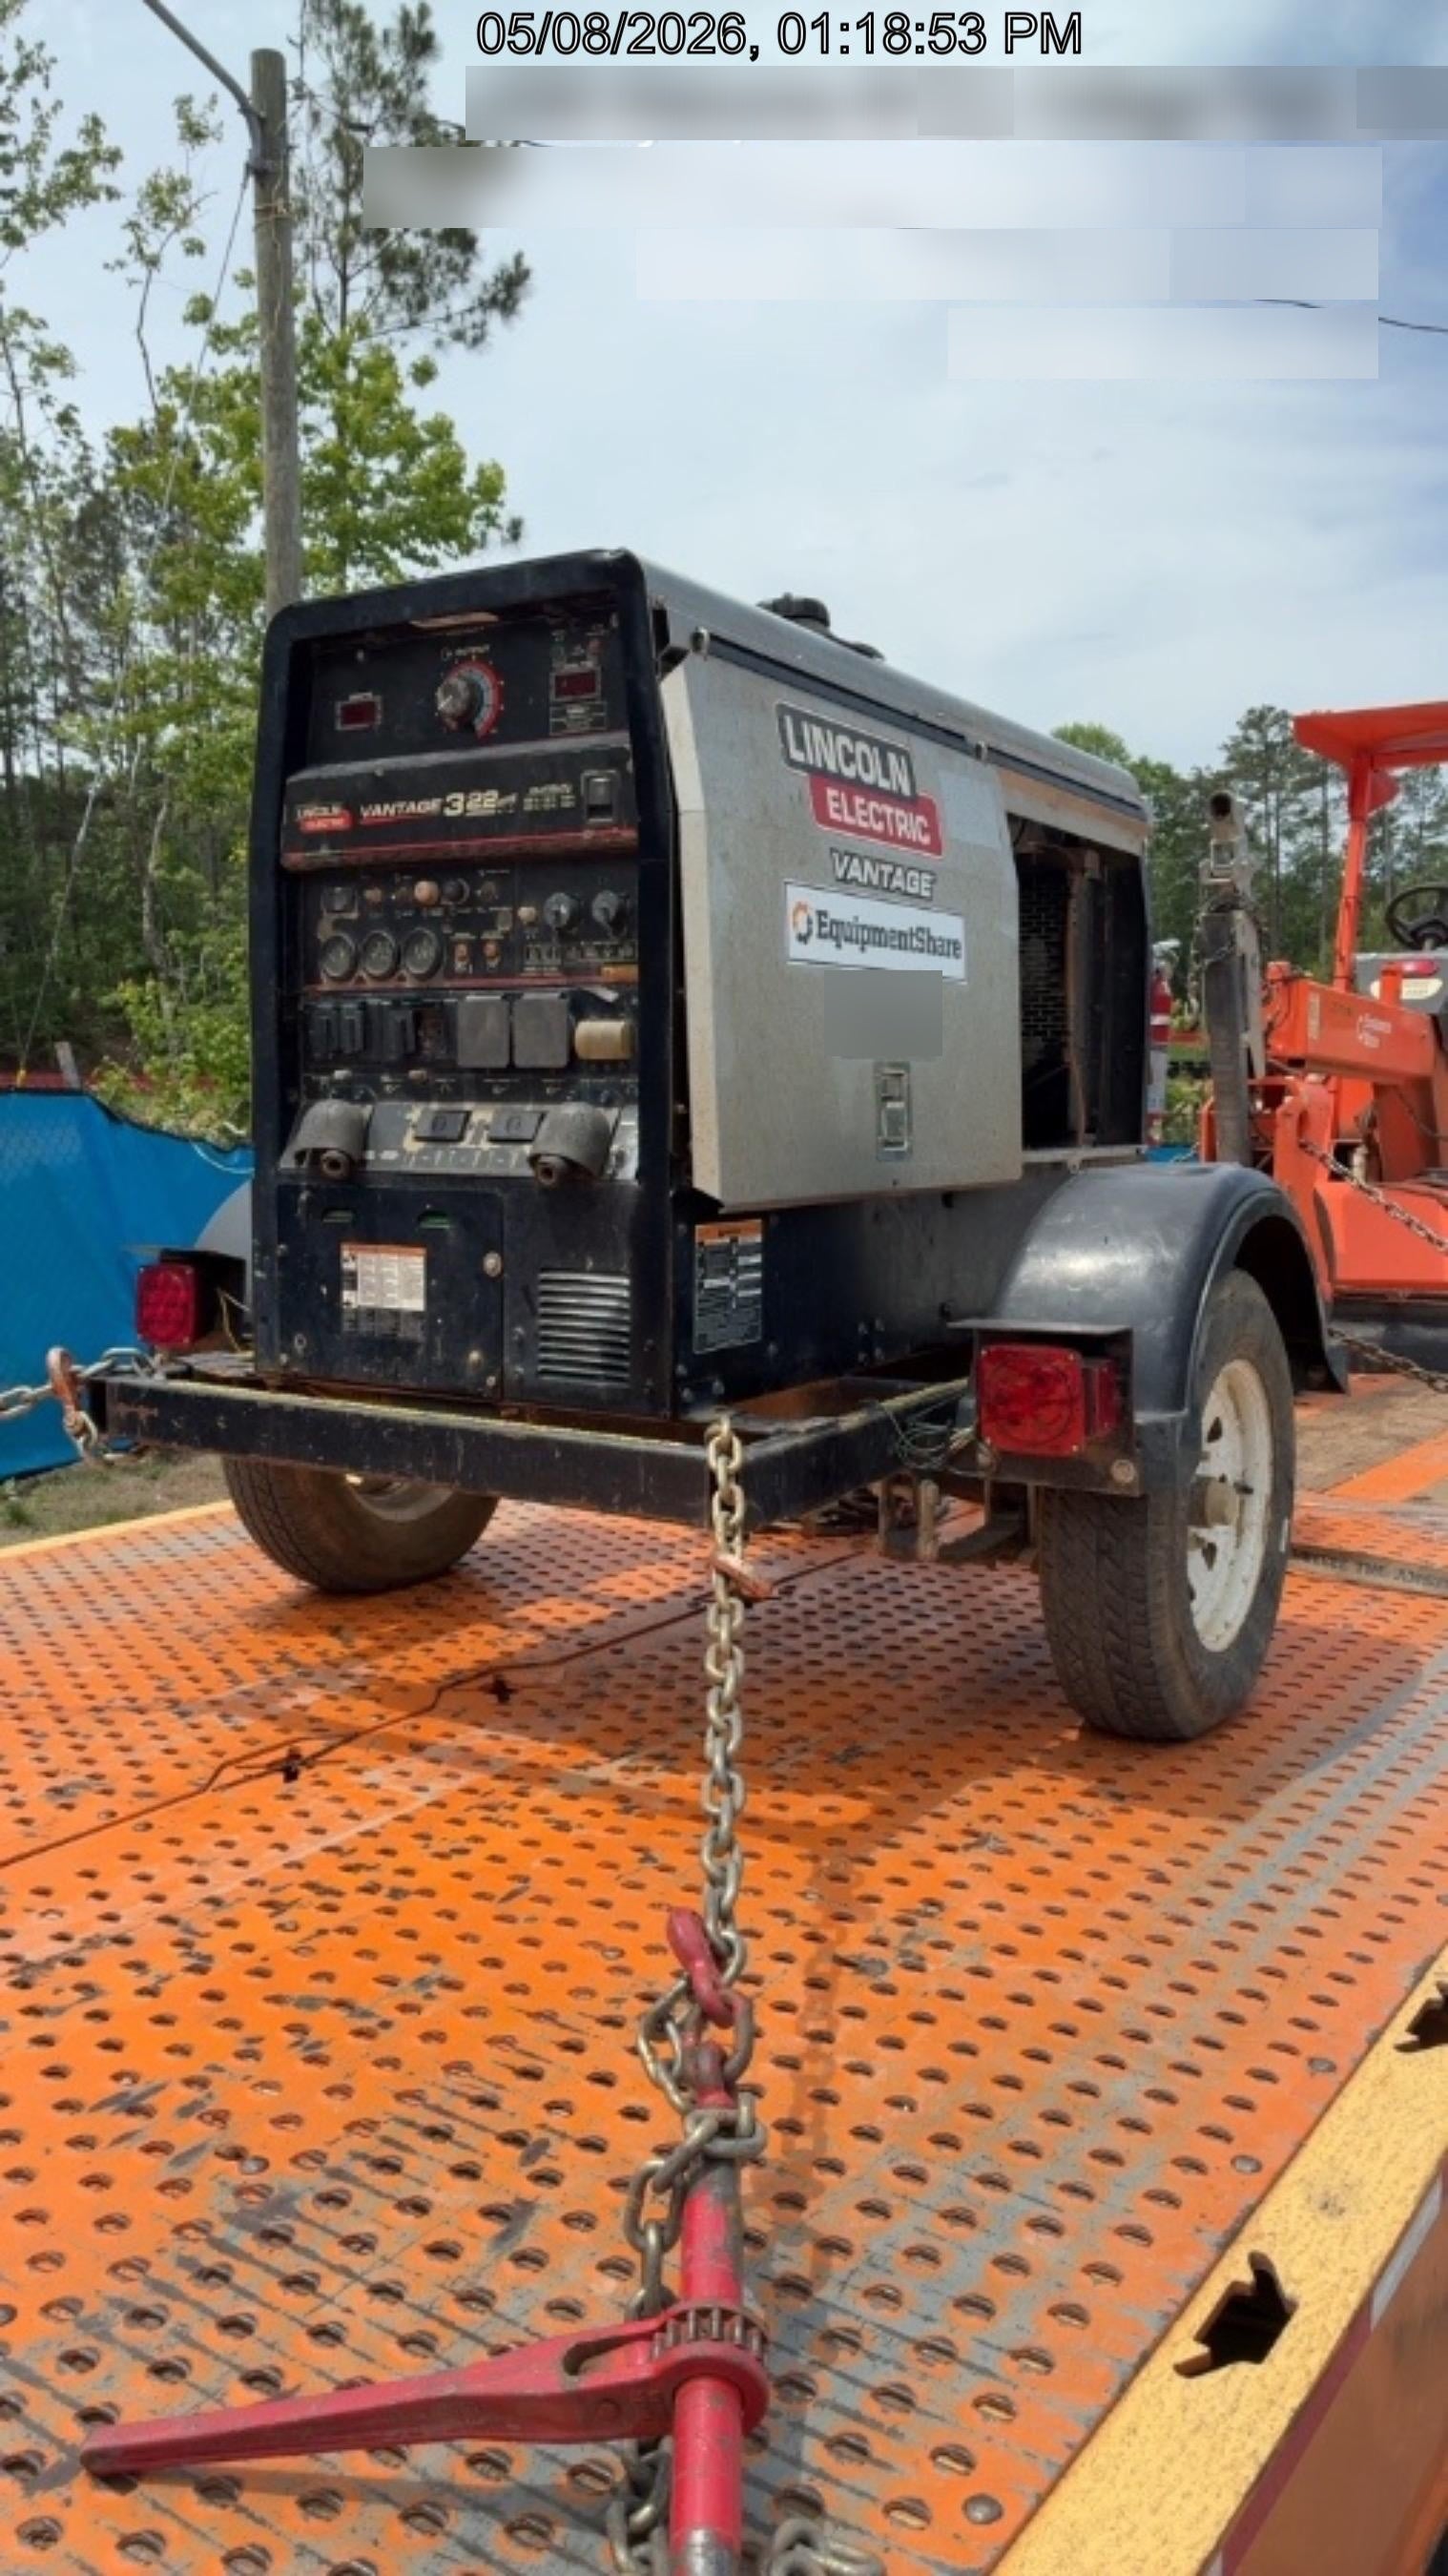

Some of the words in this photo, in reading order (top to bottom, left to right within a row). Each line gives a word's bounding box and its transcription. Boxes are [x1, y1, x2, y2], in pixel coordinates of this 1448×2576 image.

[784, 715, 912, 797] LINCOLN
[360, 798, 443, 819] VANTAGE
[826, 788, 932, 845] ELECTRIC
[831, 850, 936, 900] VANTAGE
[816, 910, 962, 960] EquipmentShare
